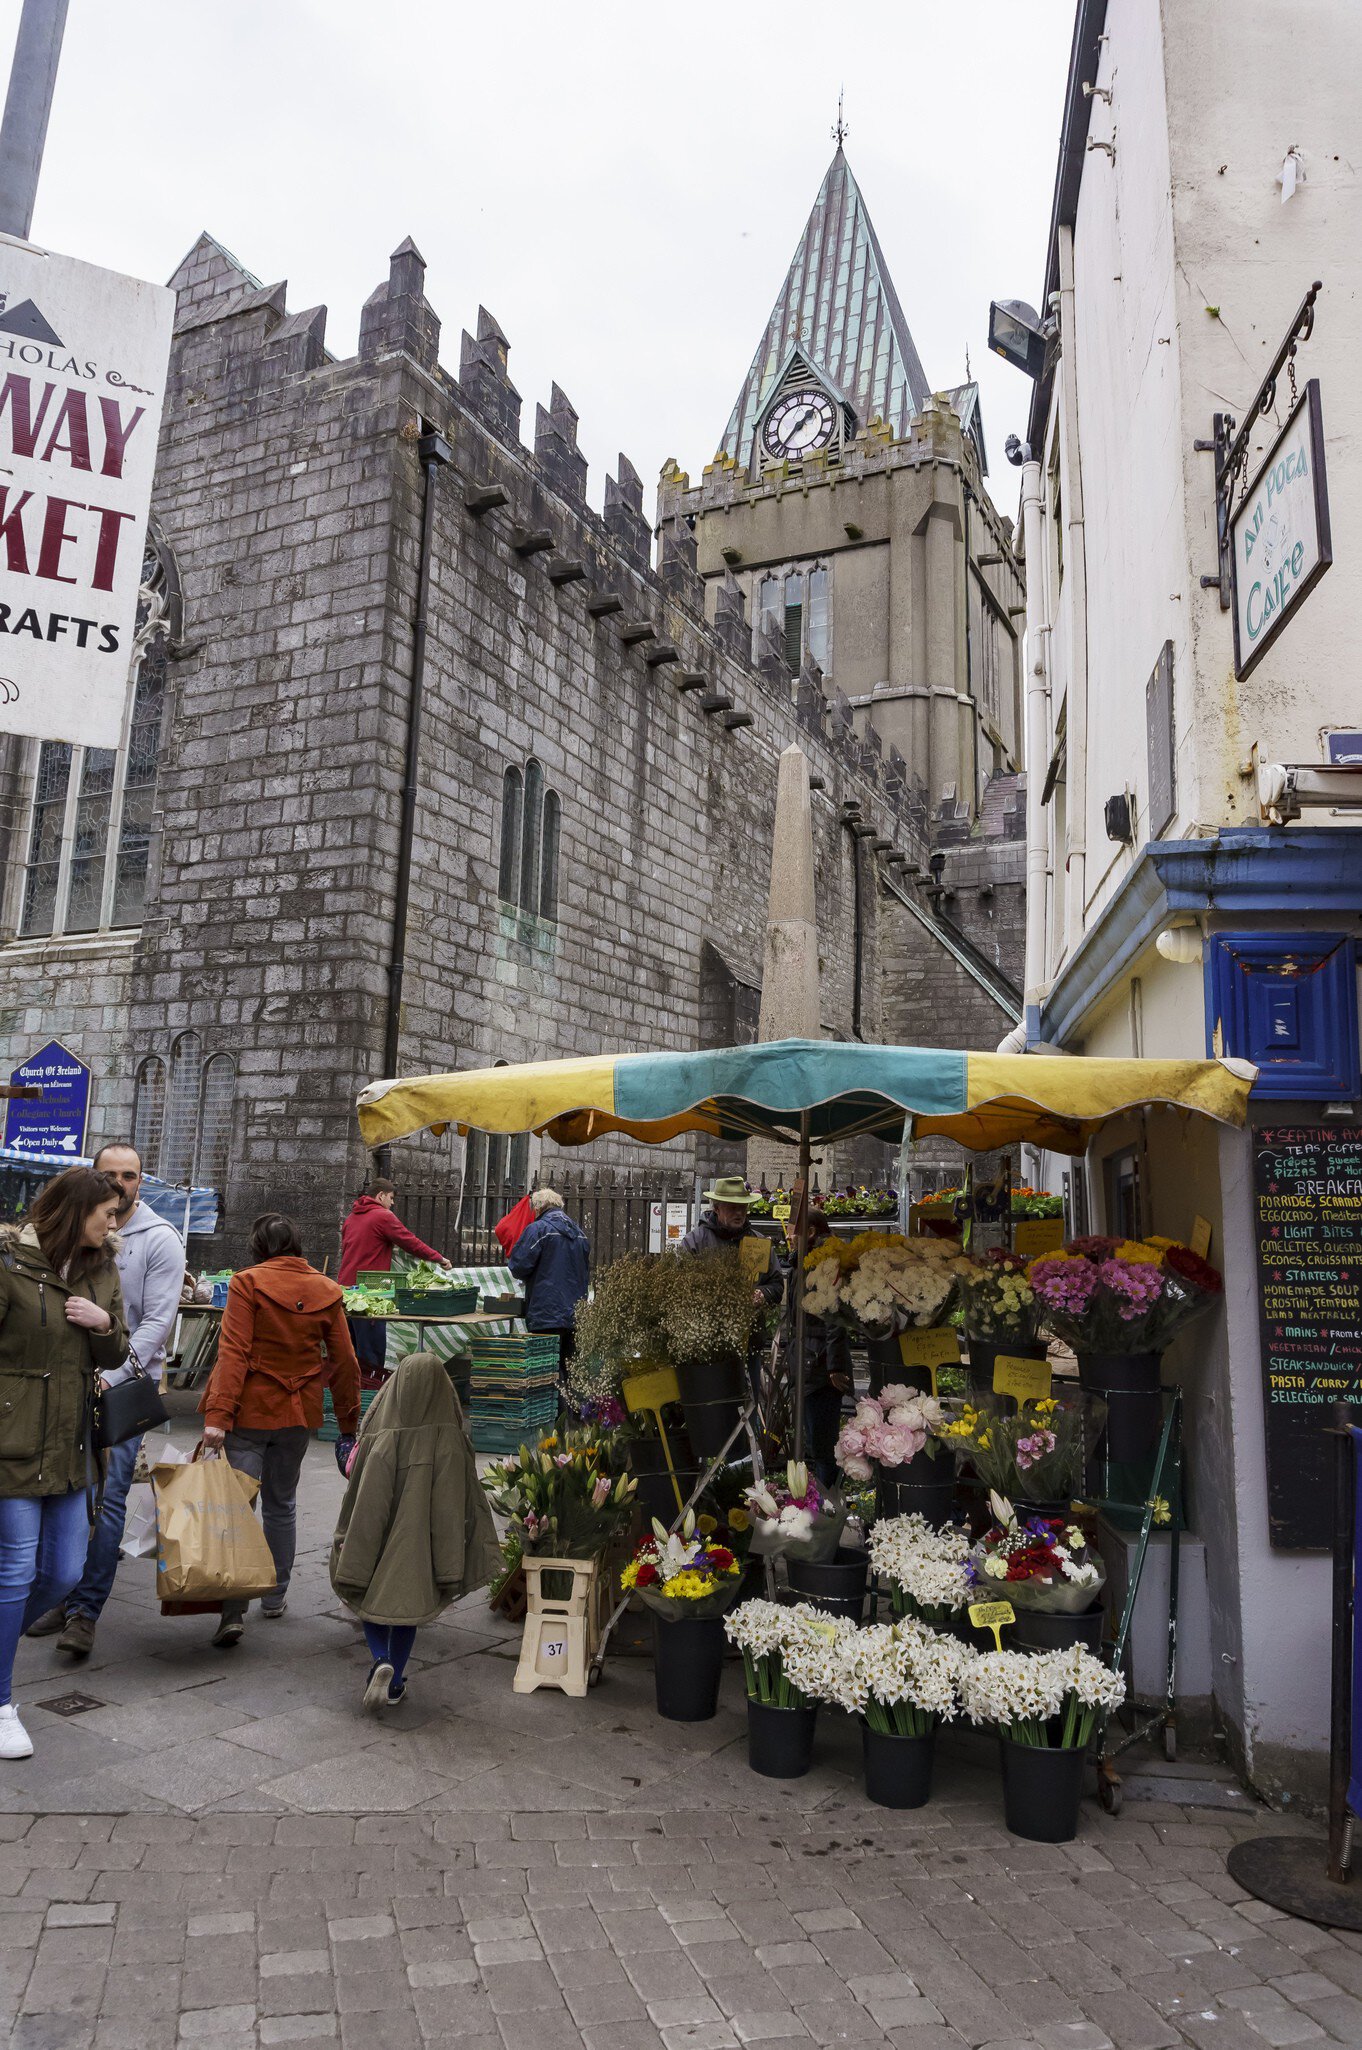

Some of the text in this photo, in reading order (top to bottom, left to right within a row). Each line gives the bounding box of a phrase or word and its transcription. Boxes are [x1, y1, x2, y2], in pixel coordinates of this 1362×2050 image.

[20, 1066, 44, 1078] Church
[56, 1065, 82, 1076] Ireland
[53, 1107, 82, 1118] Church
[1277, 1128, 1362, 1142] SEATING AV
[23, 1137, 59, 1148] Open Daily
[1319, 1196, 1362, 1207] SCRAMB
[1284, 1225, 1315, 1238] LIGHT
[1285, 1270, 1339, 1281] STARTERS
[1264, 1284, 1360, 1296] HOMEMADE SOUP
[1314, 1298, 1360, 1309] TEMPURA
[1266, 1310, 1294, 1319] LAMB
[1330, 1329, 1353, 1338] FROM
[1269, 1342, 1328, 1353] VEGETARIAN
[1269, 1357, 1303, 1371] STEAK
[1270, 1375, 1305, 1388] PASTA
[1327, 1394, 1338, 1404] OF
[547, 1643, 563, 1656] 37
